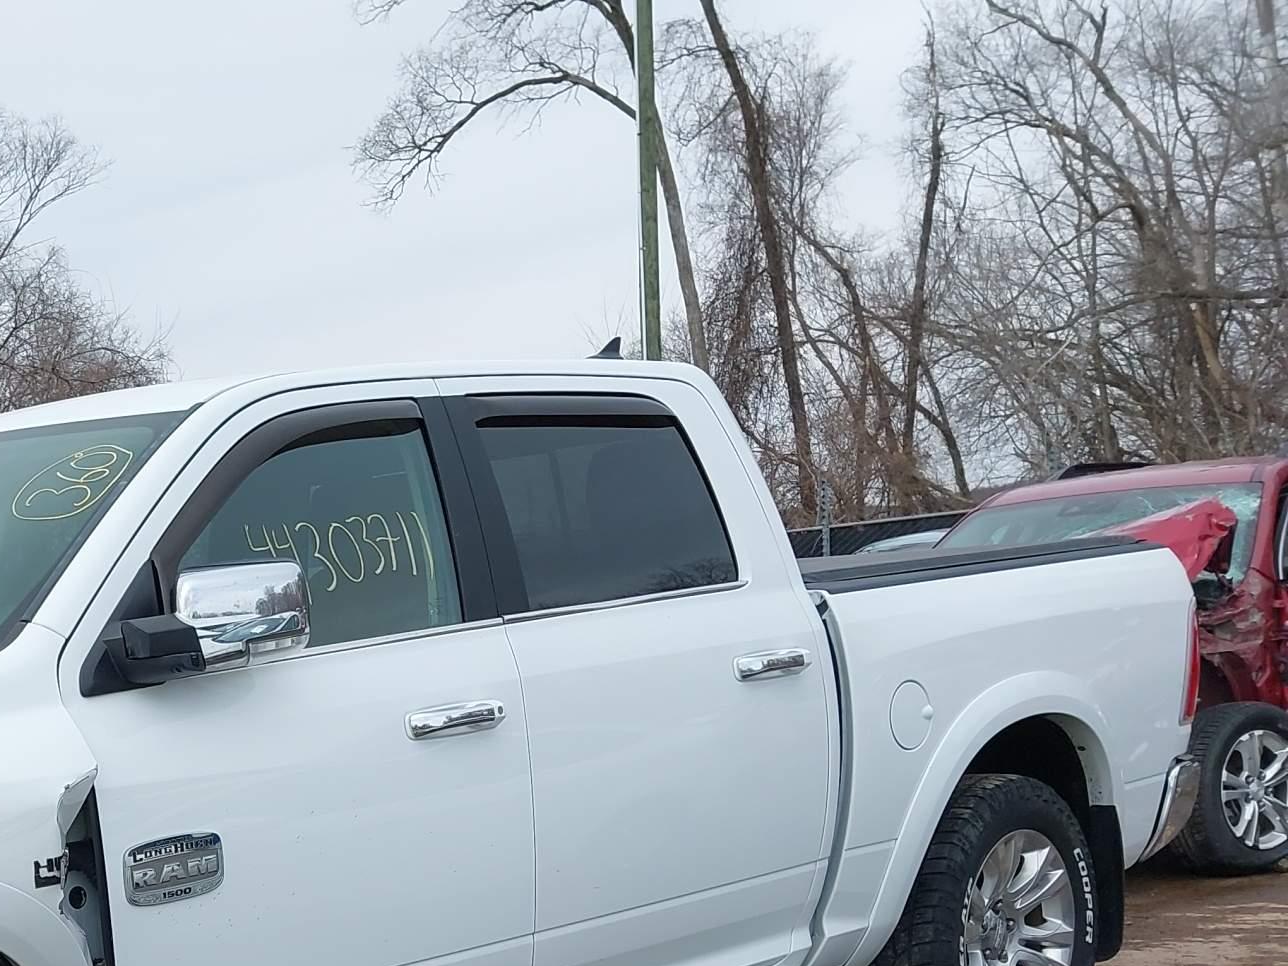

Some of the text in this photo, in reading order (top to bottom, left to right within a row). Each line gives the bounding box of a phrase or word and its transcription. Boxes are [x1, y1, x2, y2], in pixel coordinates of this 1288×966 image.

[24, 449, 119, 508] 360
[242, 511, 436, 606] 44303711
[132, 854, 218, 890] RAM
[162, 886, 193, 899] 1500
[1073, 847, 1094, 945] COOPER
